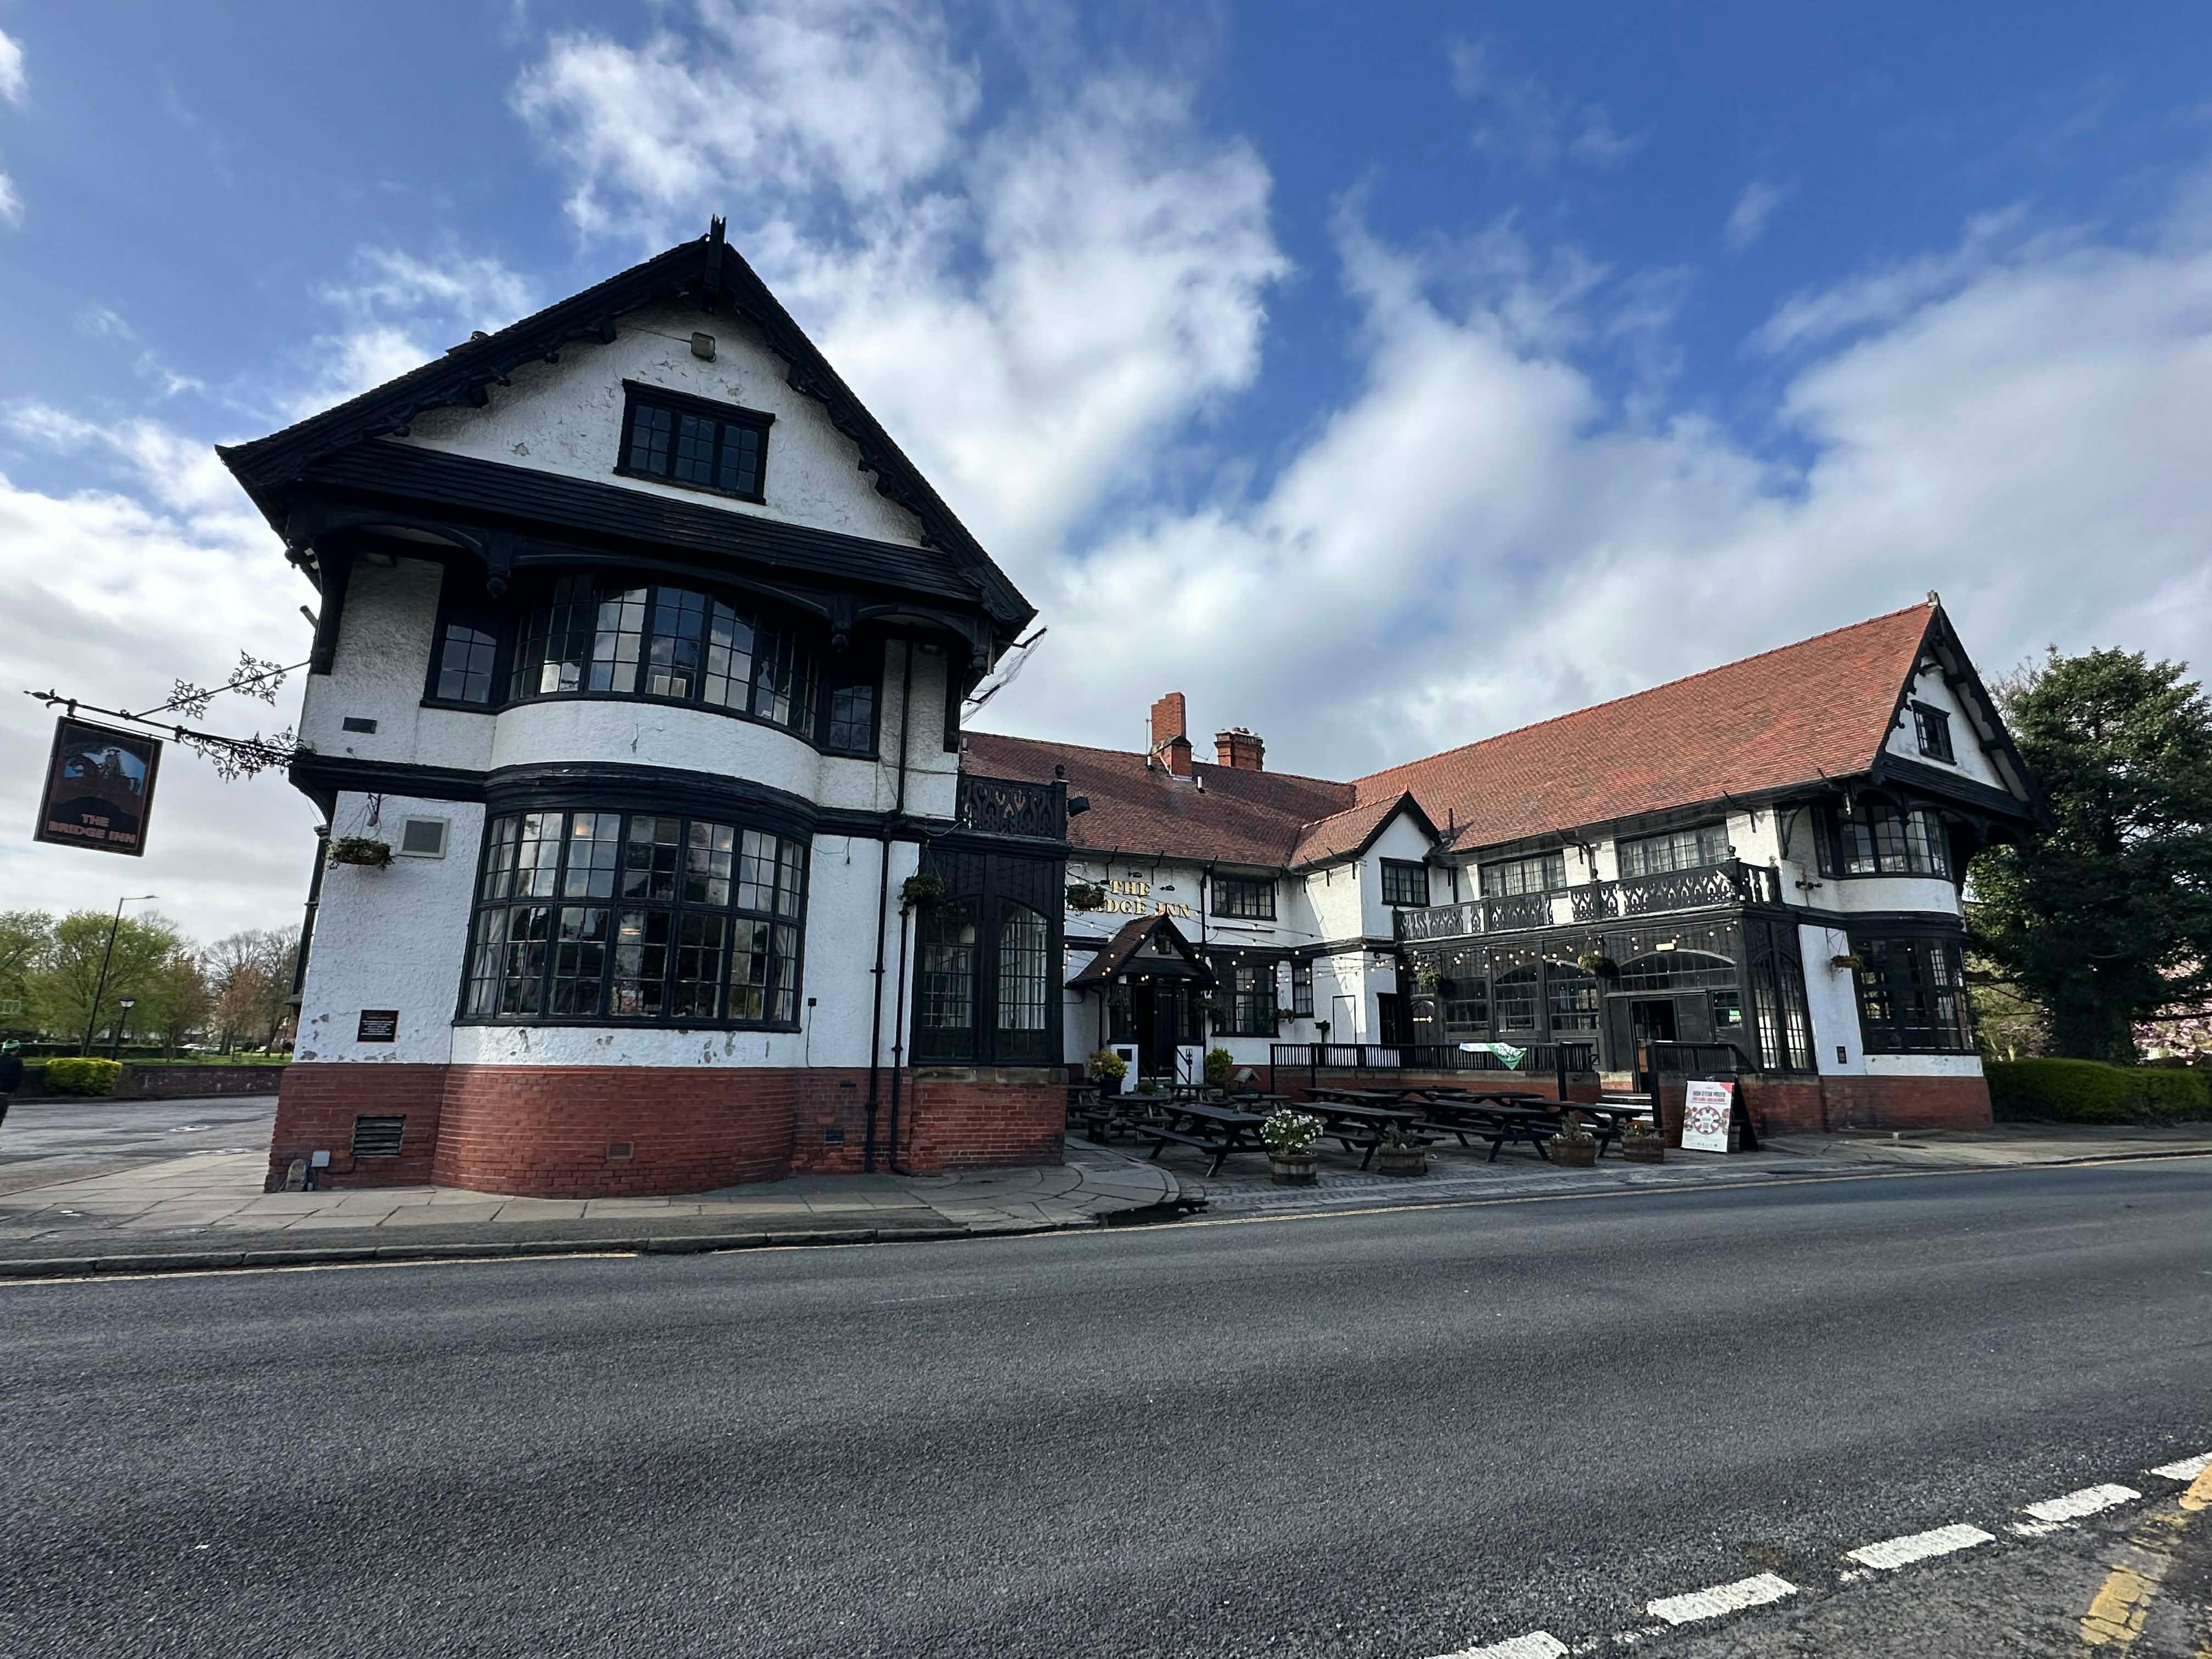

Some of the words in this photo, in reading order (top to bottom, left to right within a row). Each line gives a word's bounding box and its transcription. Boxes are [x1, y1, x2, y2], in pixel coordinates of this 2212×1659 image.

[81, 814, 109, 827] THE
[48, 821, 105, 838] BRIDGE
[109, 831, 136, 843] INN
[1110, 880, 1150, 895] THE
[1098, 898, 1148, 914] DGE
[1156, 902, 1190, 917] INN
